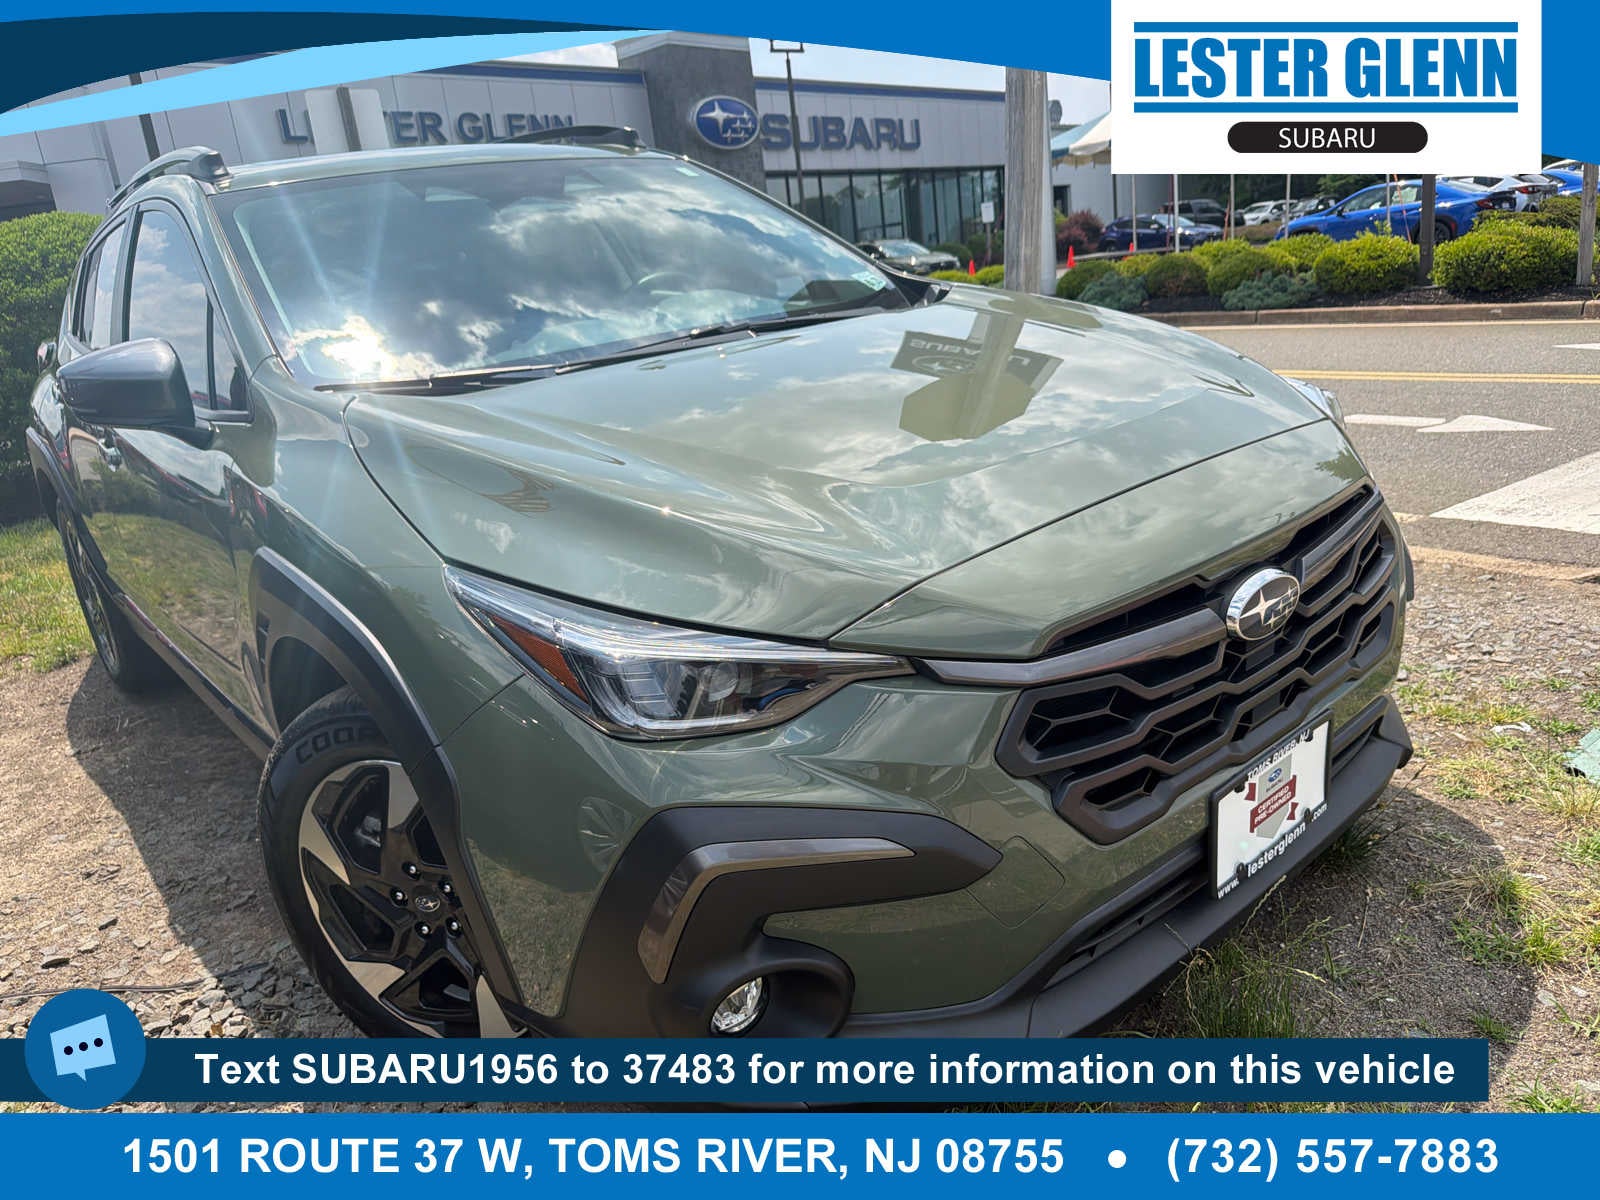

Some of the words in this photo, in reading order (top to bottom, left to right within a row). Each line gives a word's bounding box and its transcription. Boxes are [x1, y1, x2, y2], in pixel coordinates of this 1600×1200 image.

[277, 108, 448, 145] LER
[760, 113, 921, 151] SUBARU
[296, 726, 379, 764] COOP
[1254, 791, 1292, 825] PRE-OWNED
[1257, 785, 1290, 814] CERTIFIED
[1247, 822, 1306, 878] lesterglenn
